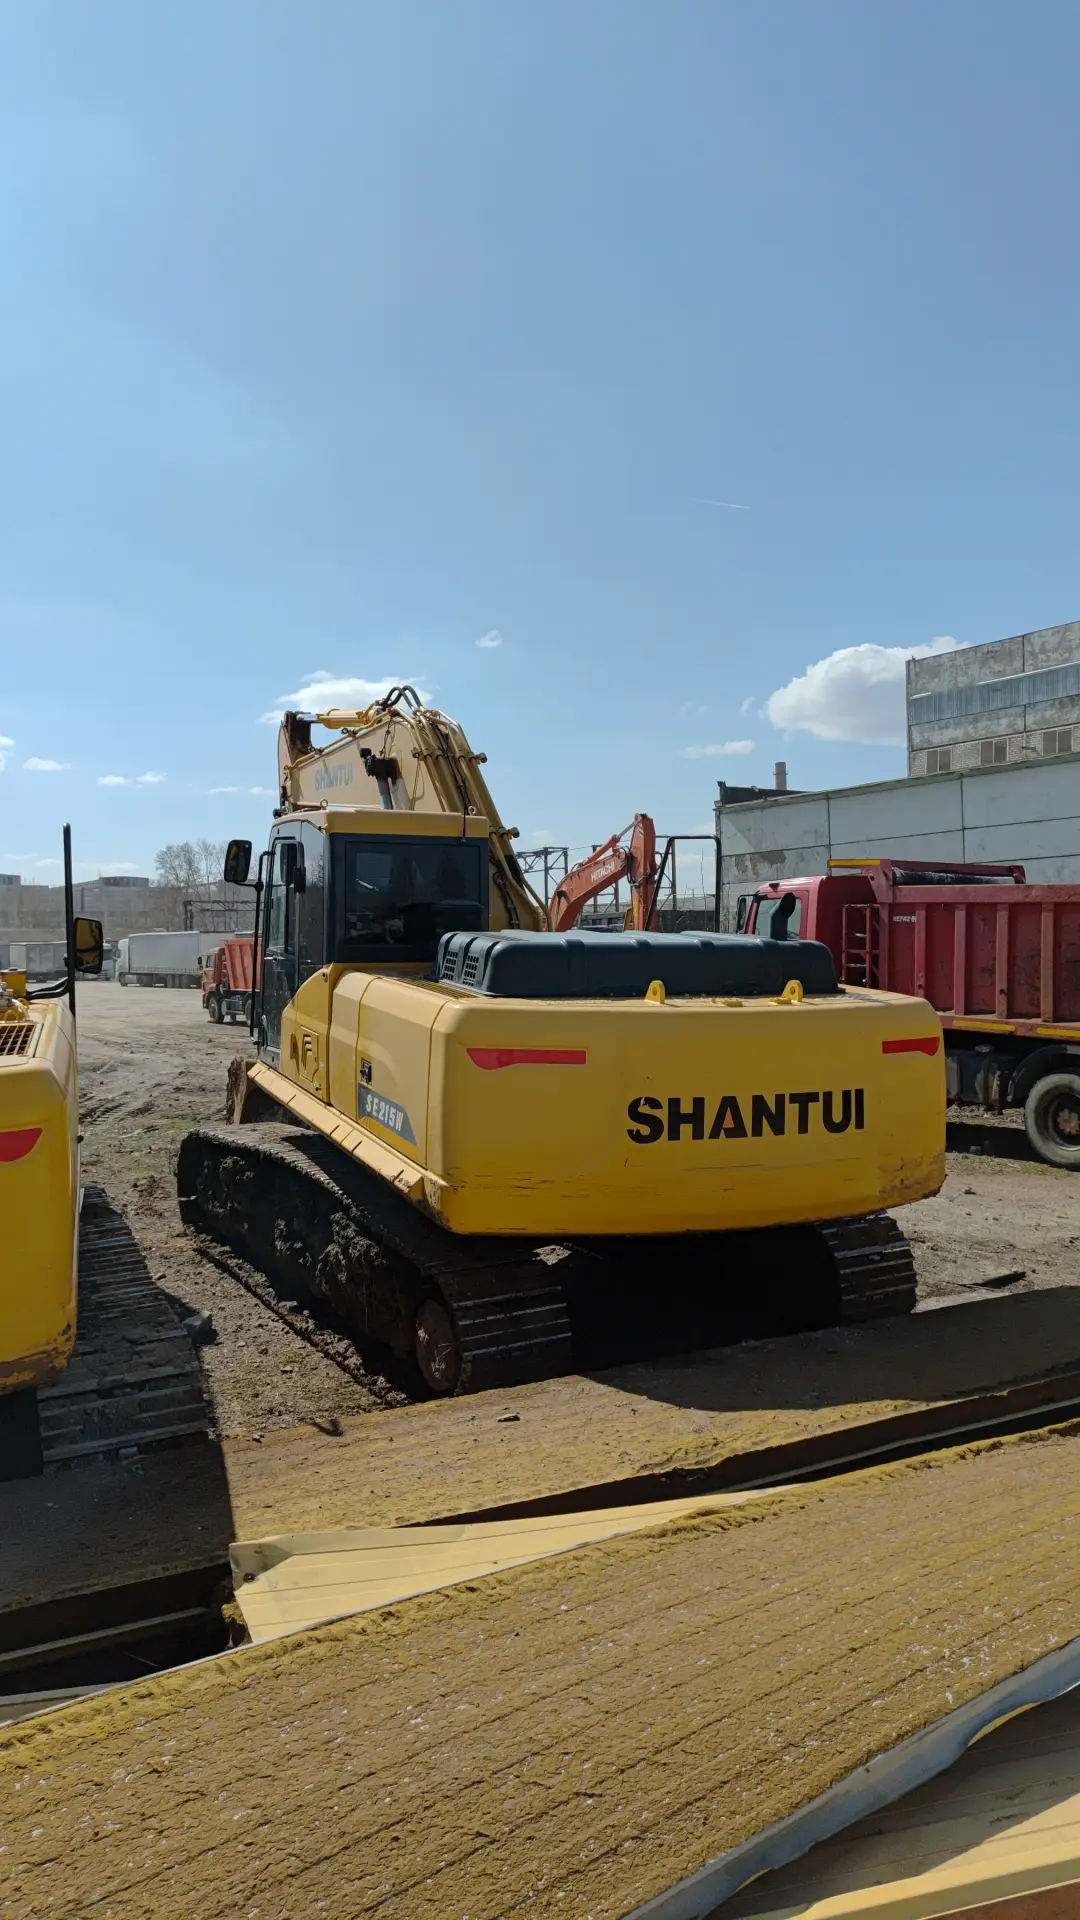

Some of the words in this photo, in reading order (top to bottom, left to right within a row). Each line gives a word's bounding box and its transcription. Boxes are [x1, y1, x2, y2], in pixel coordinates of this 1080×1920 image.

[315, 762, 353, 791] SHANTUI
[590, 861, 615, 882] HITACHI
[365, 1094, 404, 1132] SE215W
[626, 1088, 865, 1144] SHANTUI
